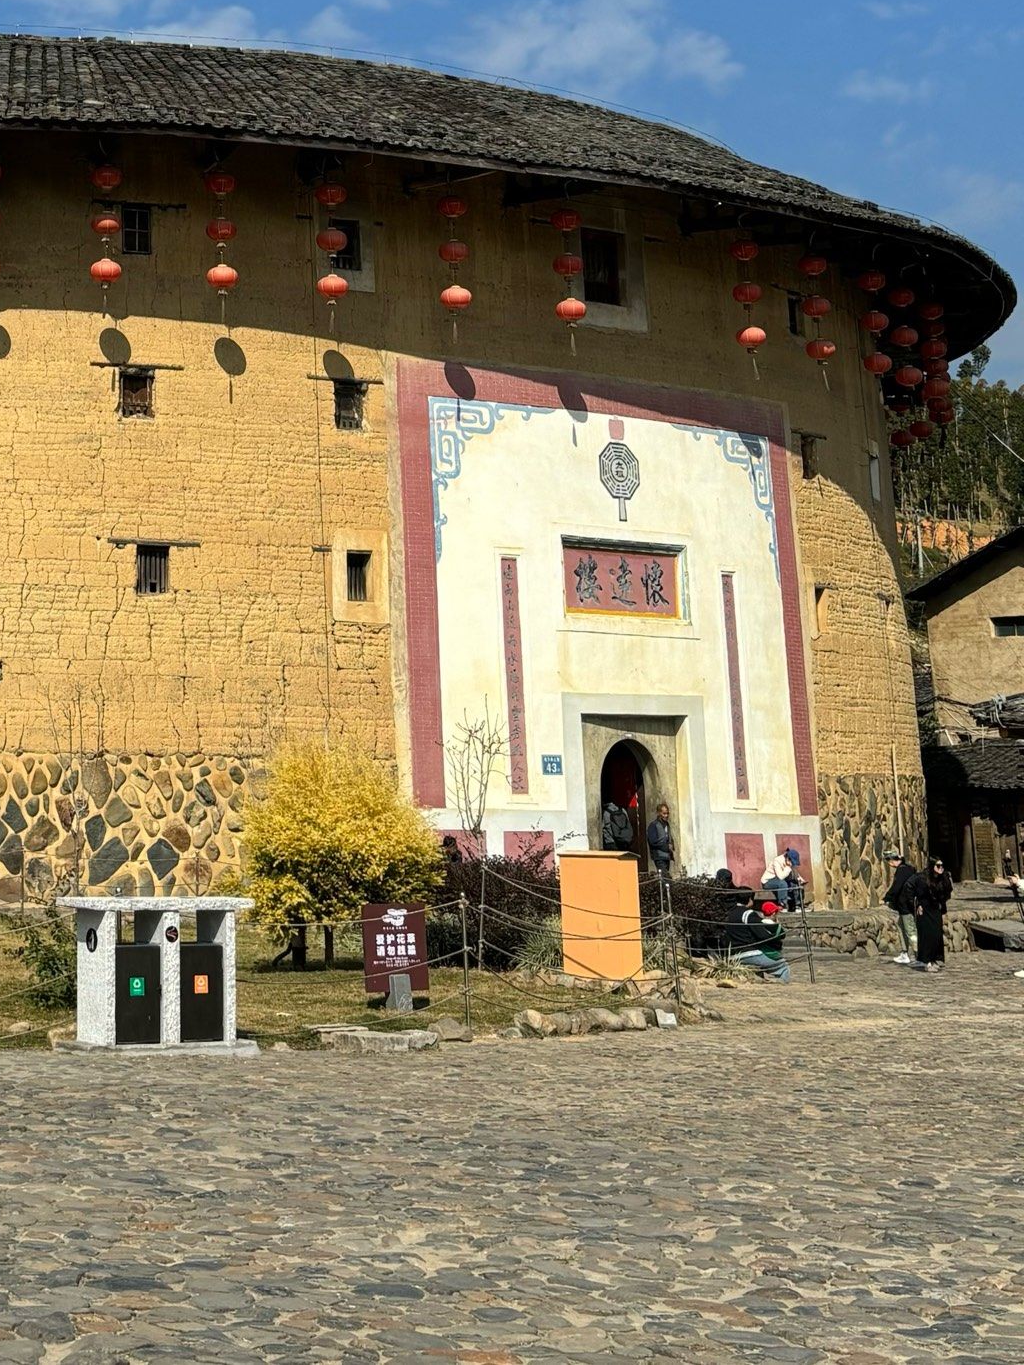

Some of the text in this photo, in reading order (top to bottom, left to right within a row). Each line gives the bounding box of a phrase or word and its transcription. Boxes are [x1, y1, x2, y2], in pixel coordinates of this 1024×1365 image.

[376, 933, 416, 945] 爱护花草
[376, 945, 417, 957] 请勿践踏
